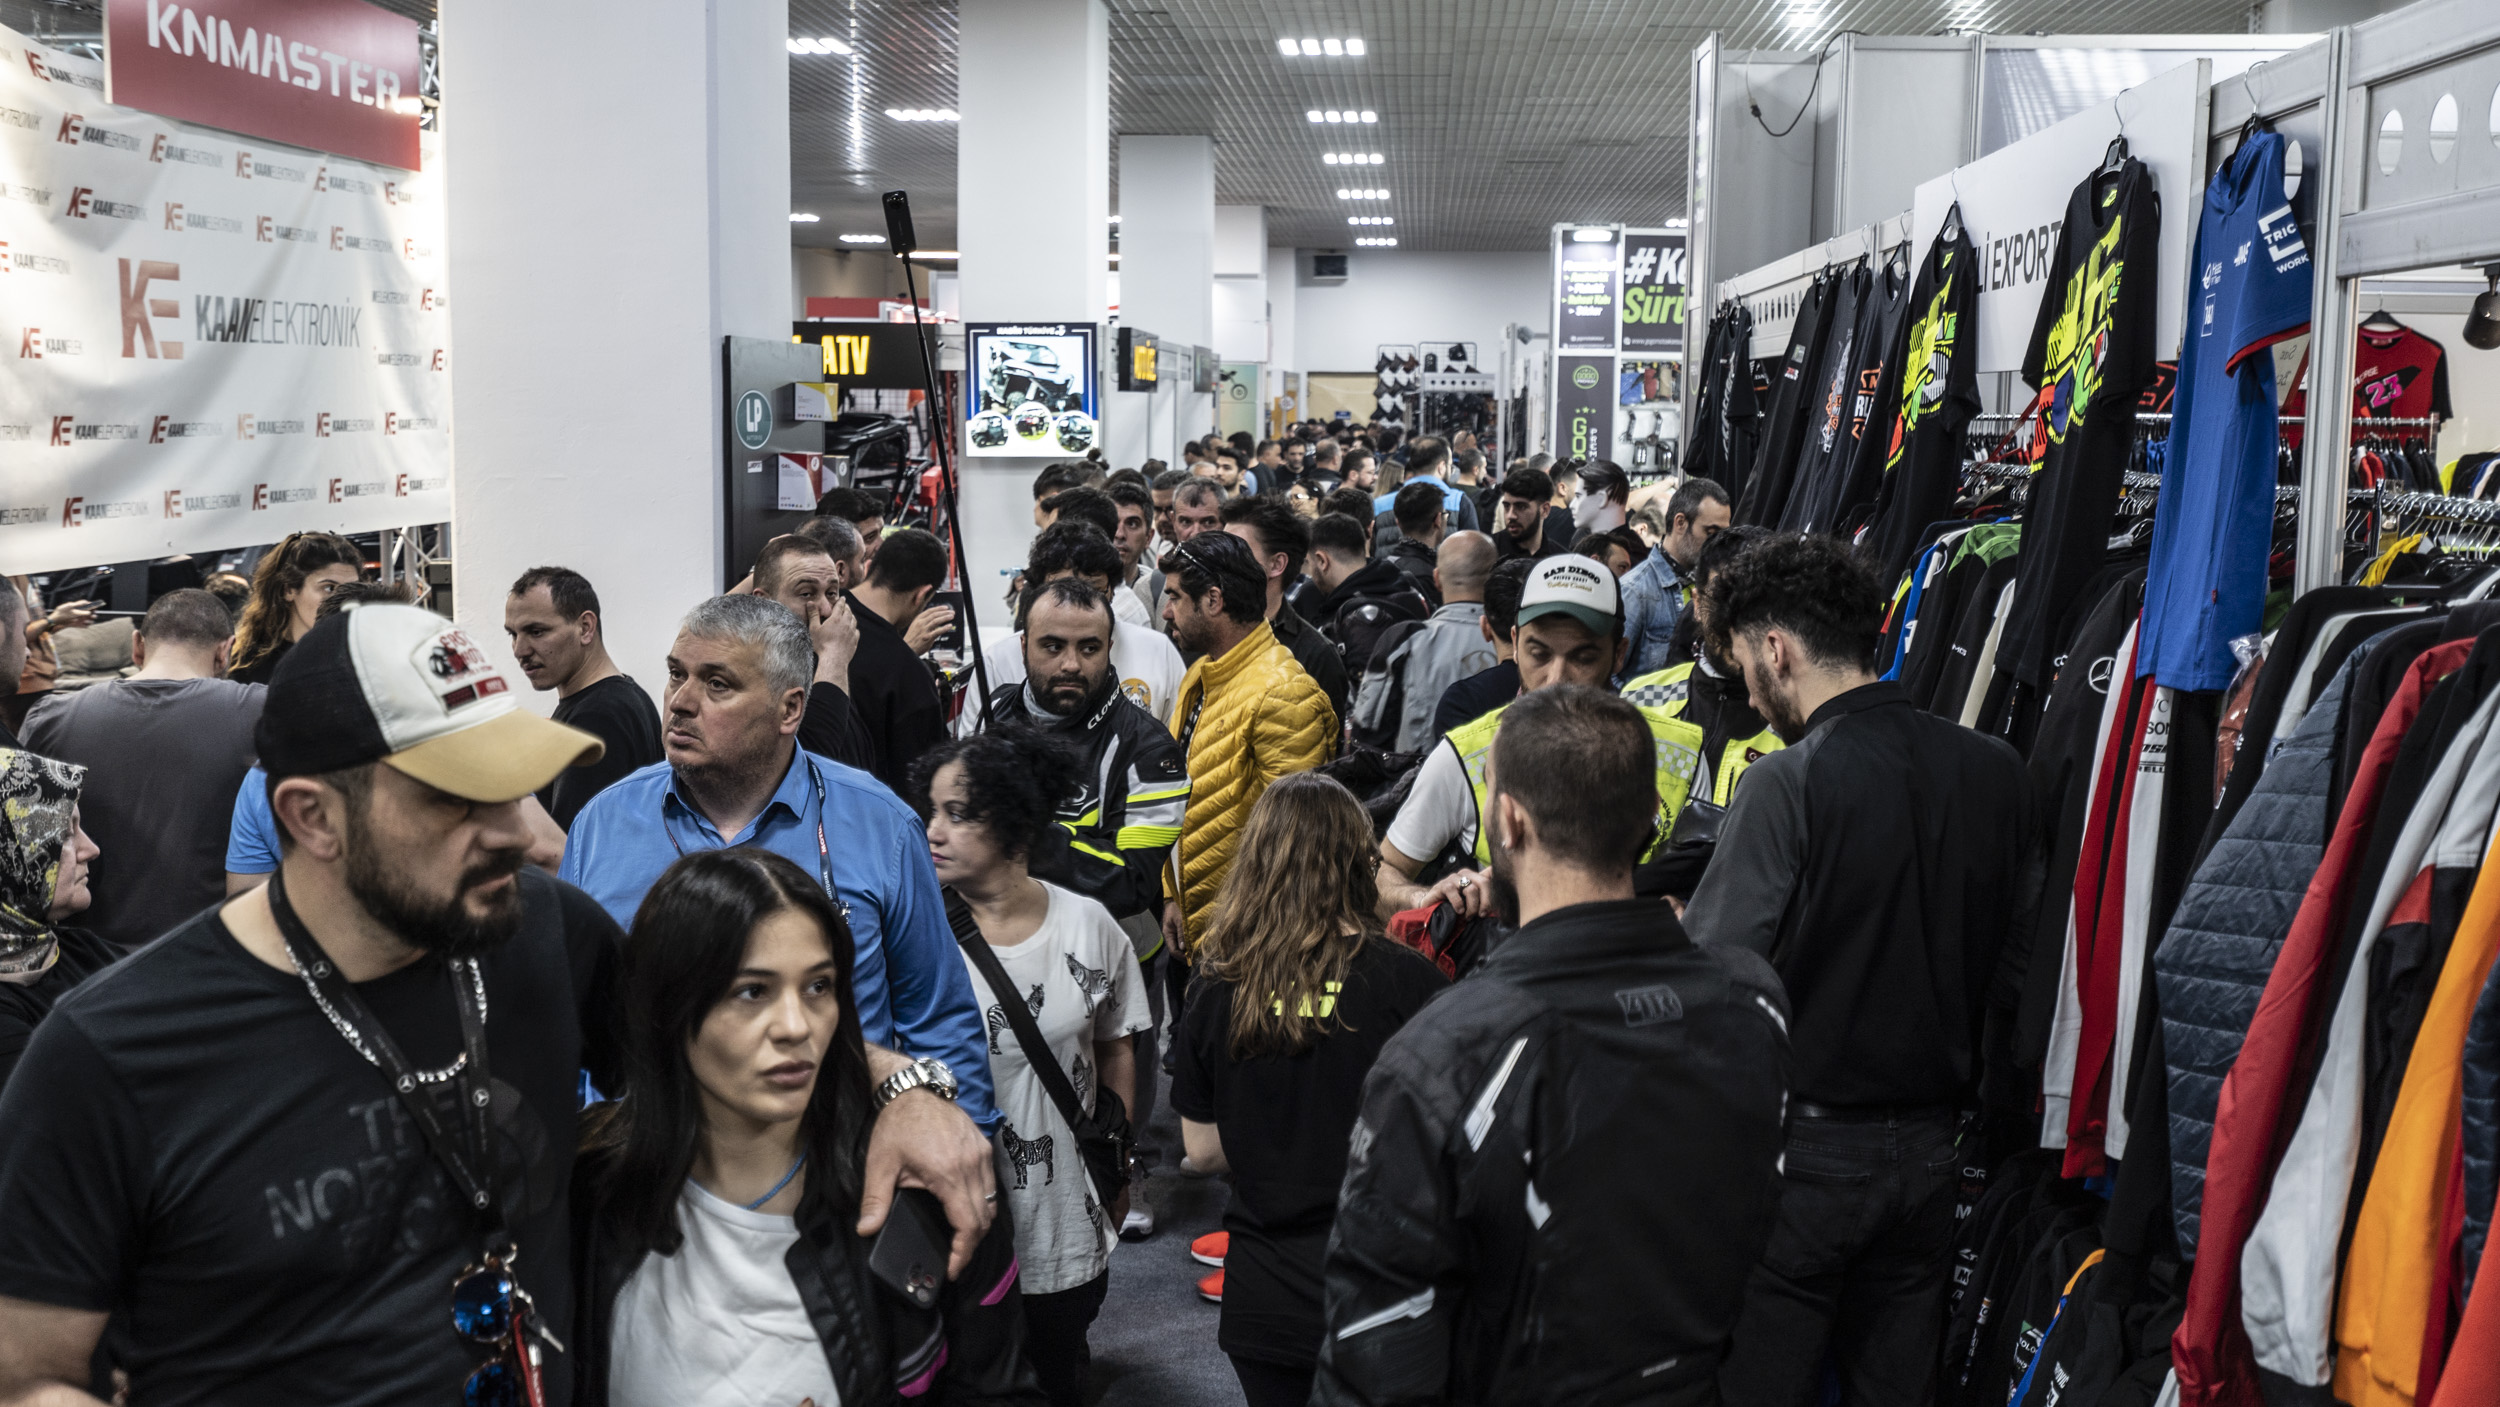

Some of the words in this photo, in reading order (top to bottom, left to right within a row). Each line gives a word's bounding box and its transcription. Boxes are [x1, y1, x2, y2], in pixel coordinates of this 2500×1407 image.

[147, 0, 402, 114] KNMASTER
[1992, 220, 2062, 291] EXPORT
[2276, 253, 2309, 274] WORK
[118, 258, 184, 359] KE
[196, 293, 361, 347] KAANELEKTRONİK
[821, 335, 870, 374] ATV
[2365, 374, 2402, 408] 23
[746, 398, 762, 432] LP
[1544, 566, 1565, 580] SAN
[1568, 566, 1600, 585] DIEGO
